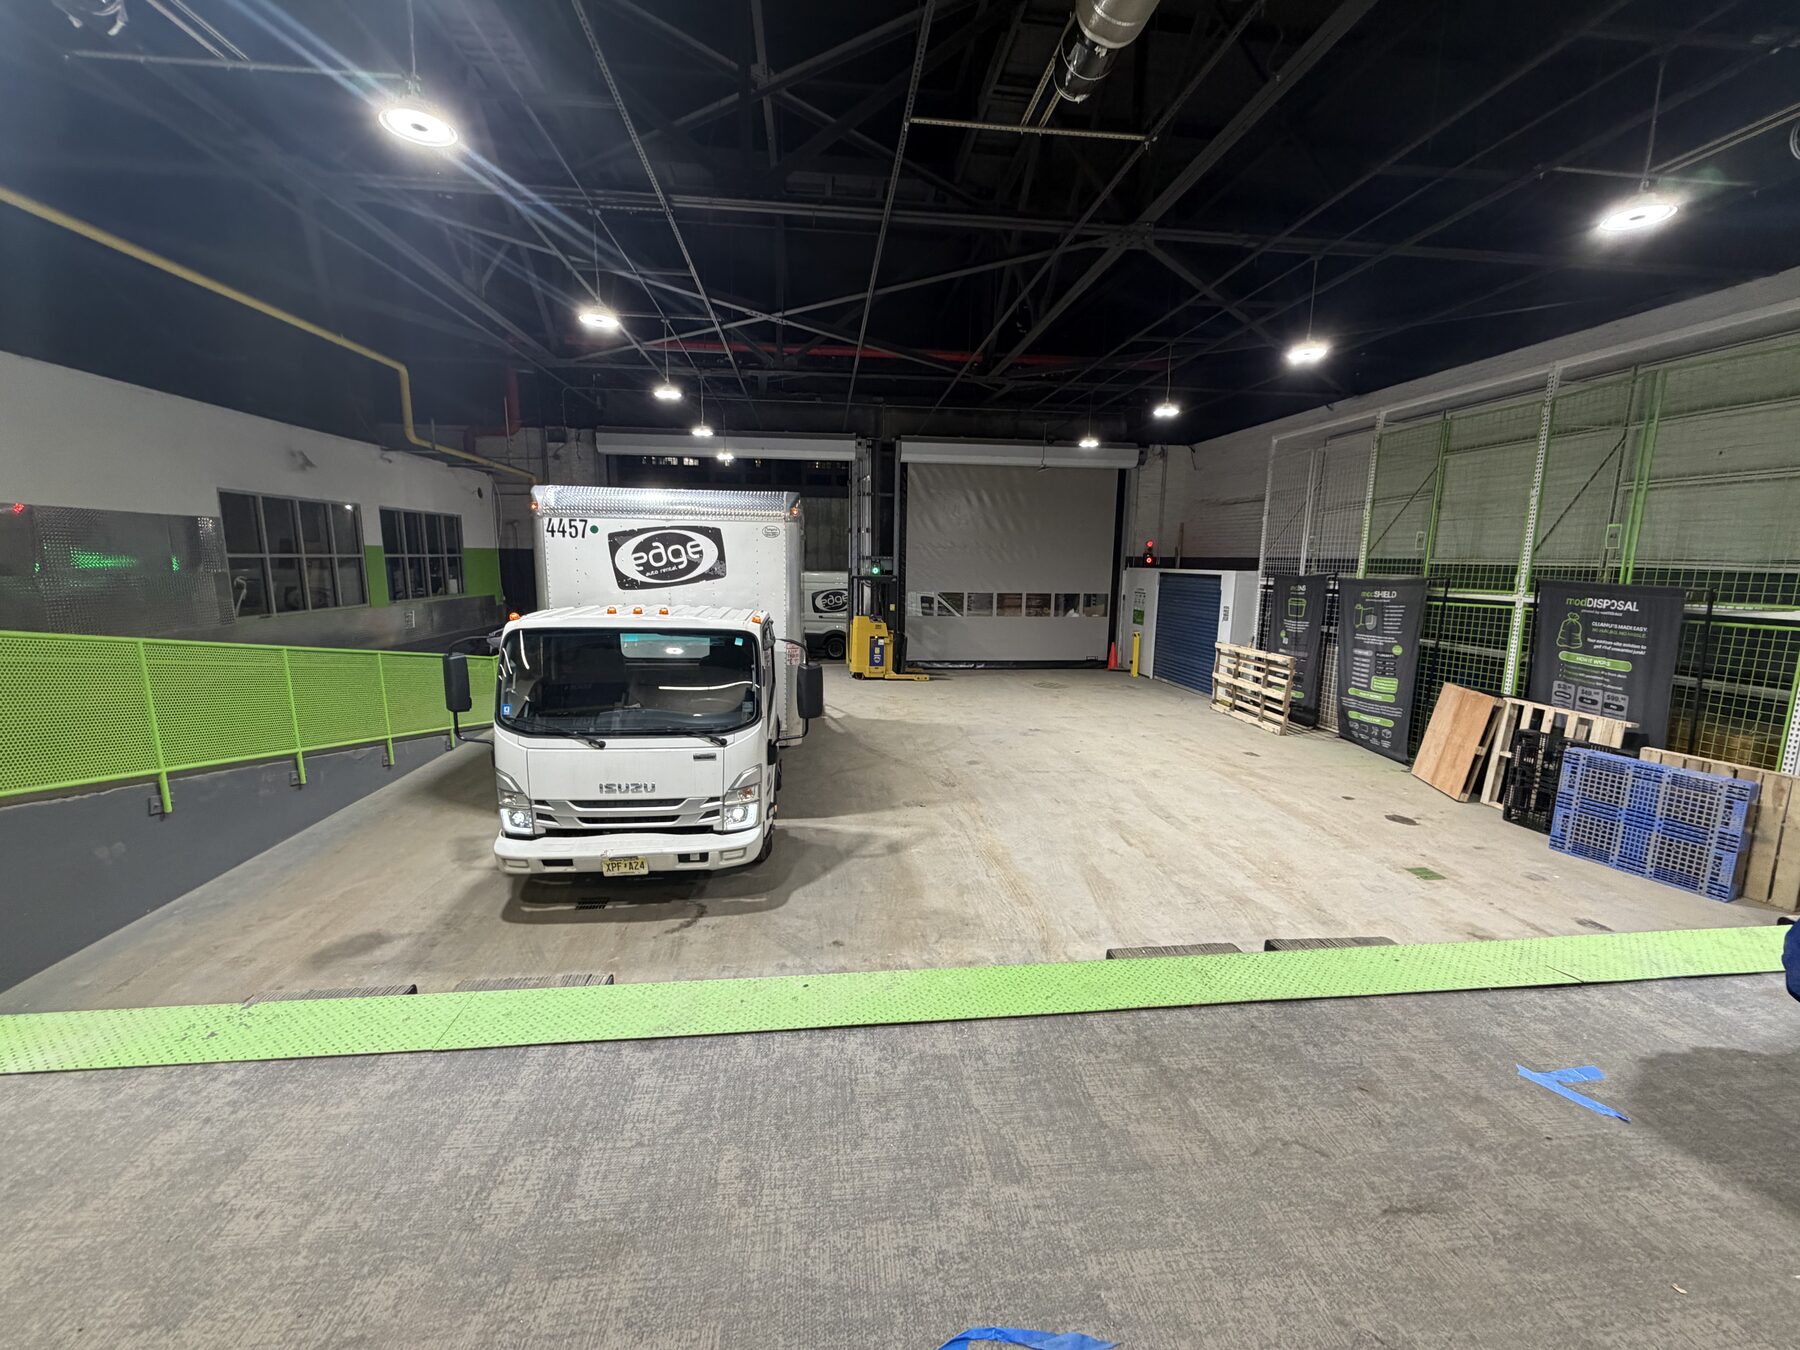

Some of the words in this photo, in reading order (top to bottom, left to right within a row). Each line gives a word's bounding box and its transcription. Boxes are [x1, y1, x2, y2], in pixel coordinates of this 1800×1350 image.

[546, 518, 588, 539] 4457
[633, 540, 704, 571] edge
[660, 566, 678, 574] rental
[1566, 598, 1639, 611] modDISPOSAL
[599, 782, 656, 794] ISUZU
